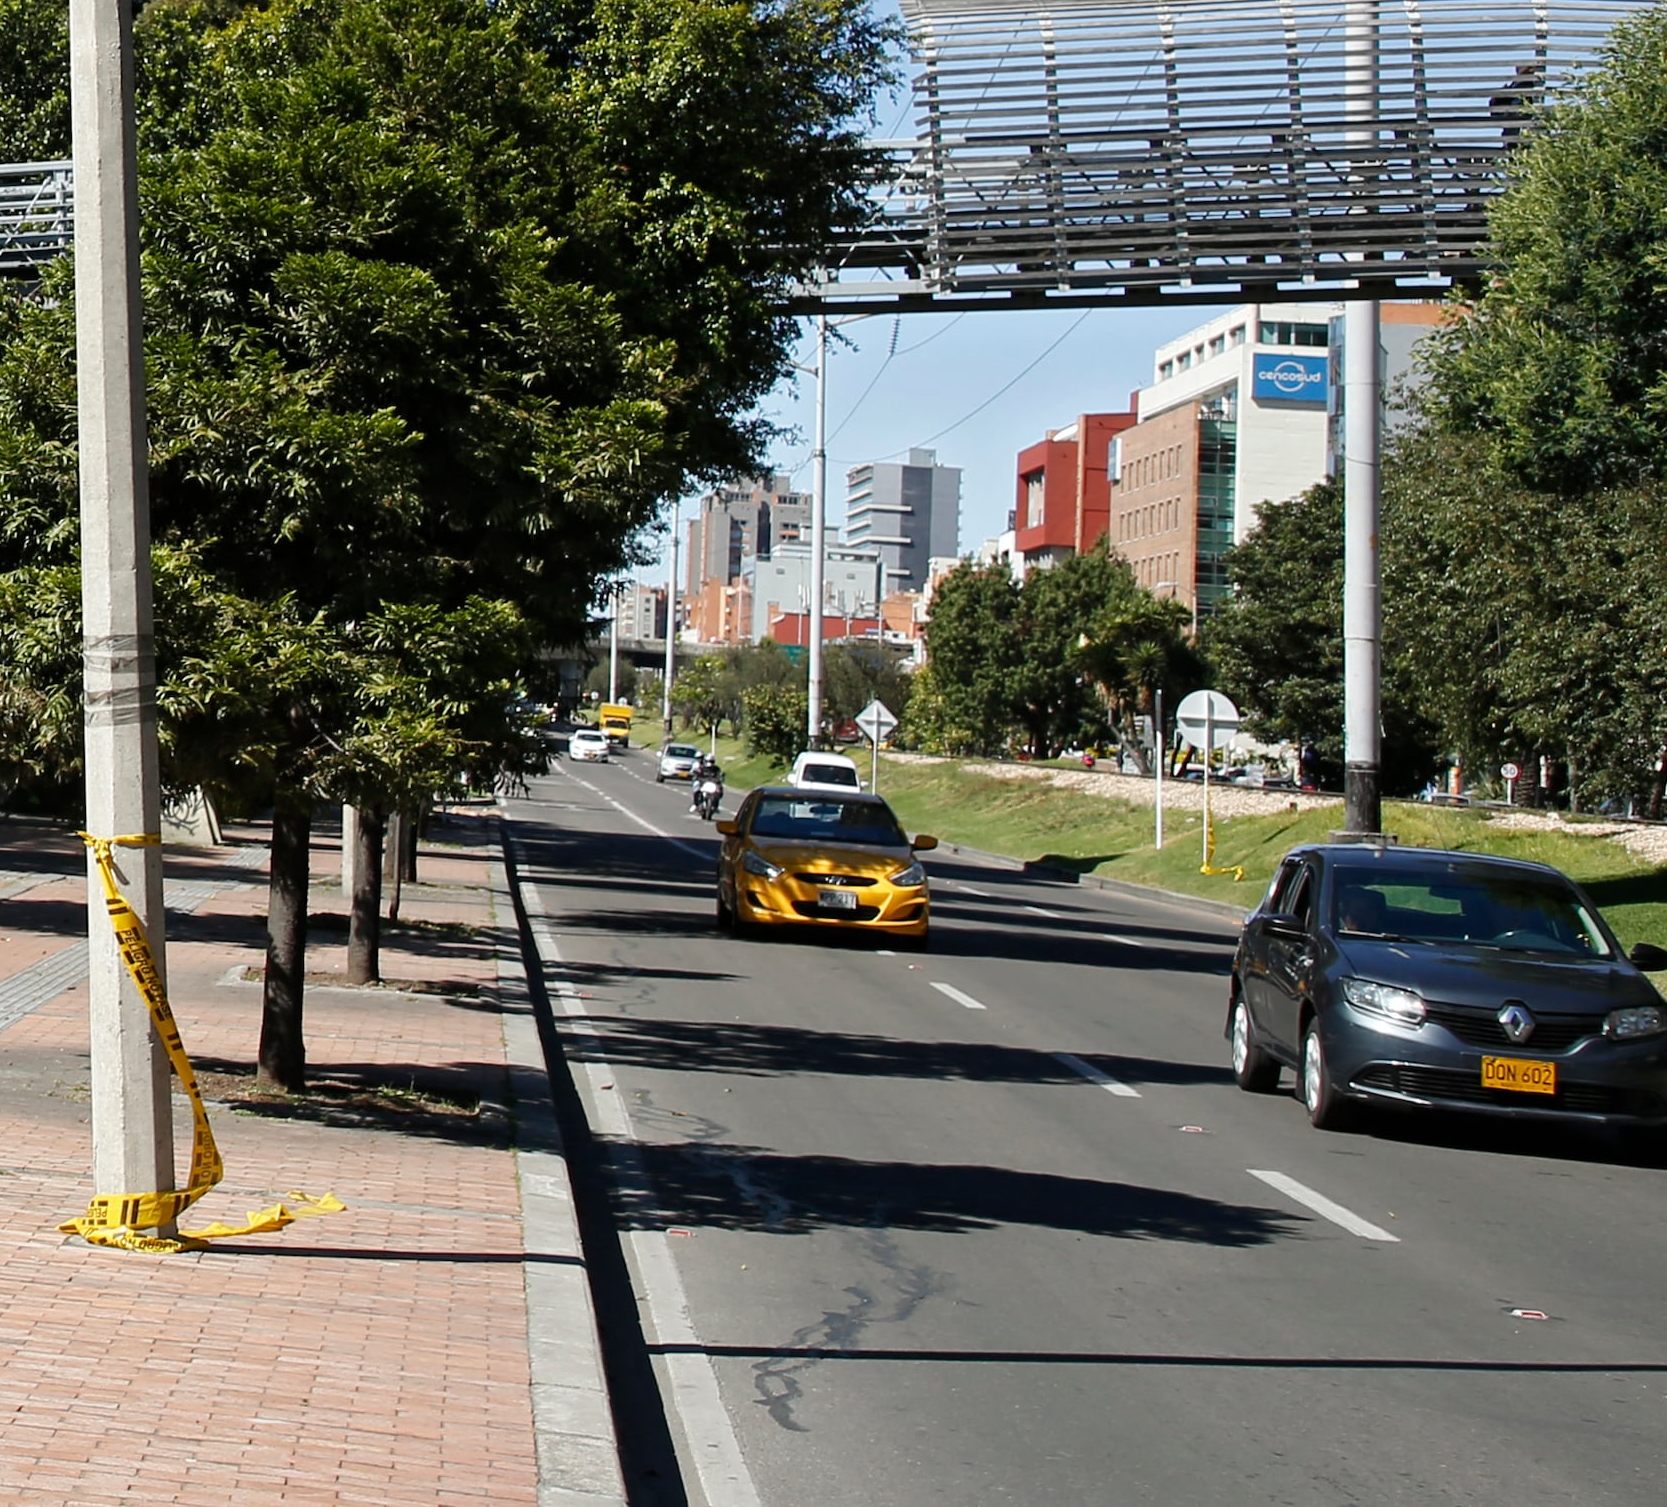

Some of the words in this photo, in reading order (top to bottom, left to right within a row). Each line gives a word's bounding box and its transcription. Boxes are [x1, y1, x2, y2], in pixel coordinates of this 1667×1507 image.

[1258, 370, 1322, 383] cencosud
[121, 929, 152, 974] PELIGRO
[146, 973, 160, 993] NO
[1486, 1062, 1517, 1082] DON
[1521, 1066, 1553, 1086] 602
